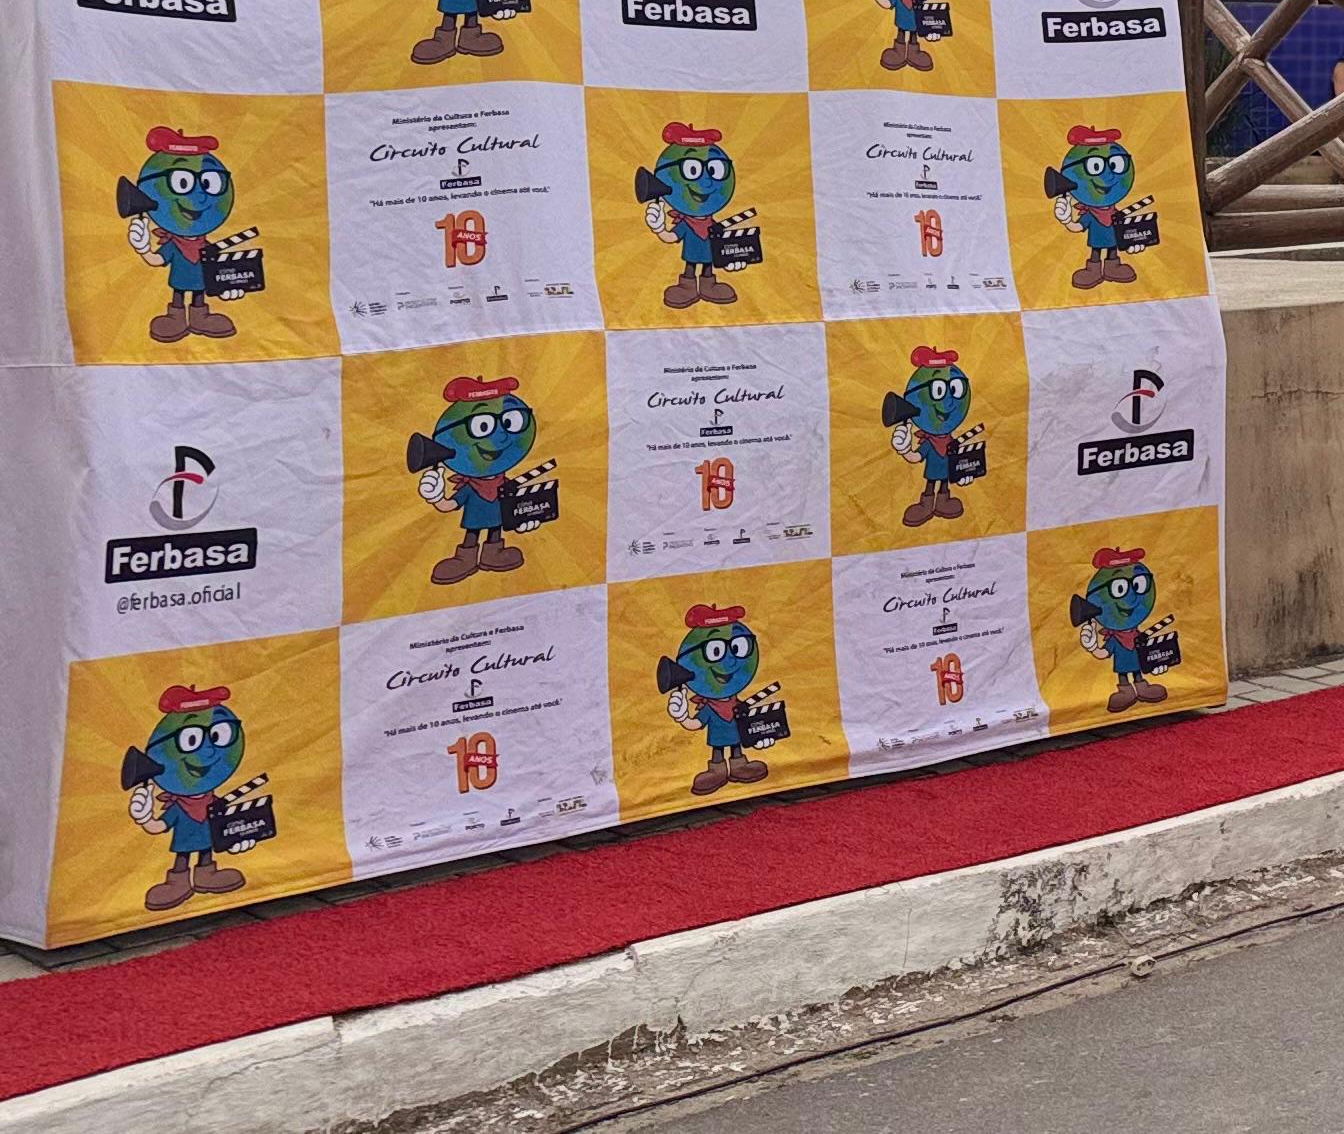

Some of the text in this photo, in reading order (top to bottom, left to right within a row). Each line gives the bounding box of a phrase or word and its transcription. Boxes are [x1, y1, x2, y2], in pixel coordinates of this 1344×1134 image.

[1047, 15, 1161, 39] Ferbasa
[480, 109, 509, 117] Ferbasa
[369, 134, 541, 162] Circuito Cultural
[866, 144, 975, 163] Circuito Cultural
[441, 178, 480, 189] Ferbasa
[385, 197, 404, 206] mais
[405, 196, 415, 204] de
[417, 195, 427, 203] 10
[435, 209, 486, 268] 10
[456, 232, 481, 241] ANOS
[215, 270, 255, 282] FERBASA
[647, 385, 786, 408] Circuito Cultural
[700, 428, 732, 436] Ferbasa
[1084, 436, 1189, 470] Ferbasa
[694, 457, 734, 511] 10
[513, 501, 551, 516] FERBASA
[111, 539, 250, 575] Ferbasa
[117, 582, 242, 615] @ferbasa.oficial
[882, 581, 997, 613] Circuito Cultural
[495, 625, 525, 635] Ferbasa
[386, 645, 556, 690] Circuito Cultural
[453, 698, 492, 712] Ferbasa
[398, 725, 417, 735] mais
[417, 723, 428, 732] de
[429, 720, 439, 729] 10
[462, 711, 494, 723] levando
[501, 706, 529, 716] cinema
[530, 703, 542, 712] até
[447, 731, 498, 794] 10
[467, 755, 493, 764] ANOS
[223, 819, 266, 836] FERBASA
